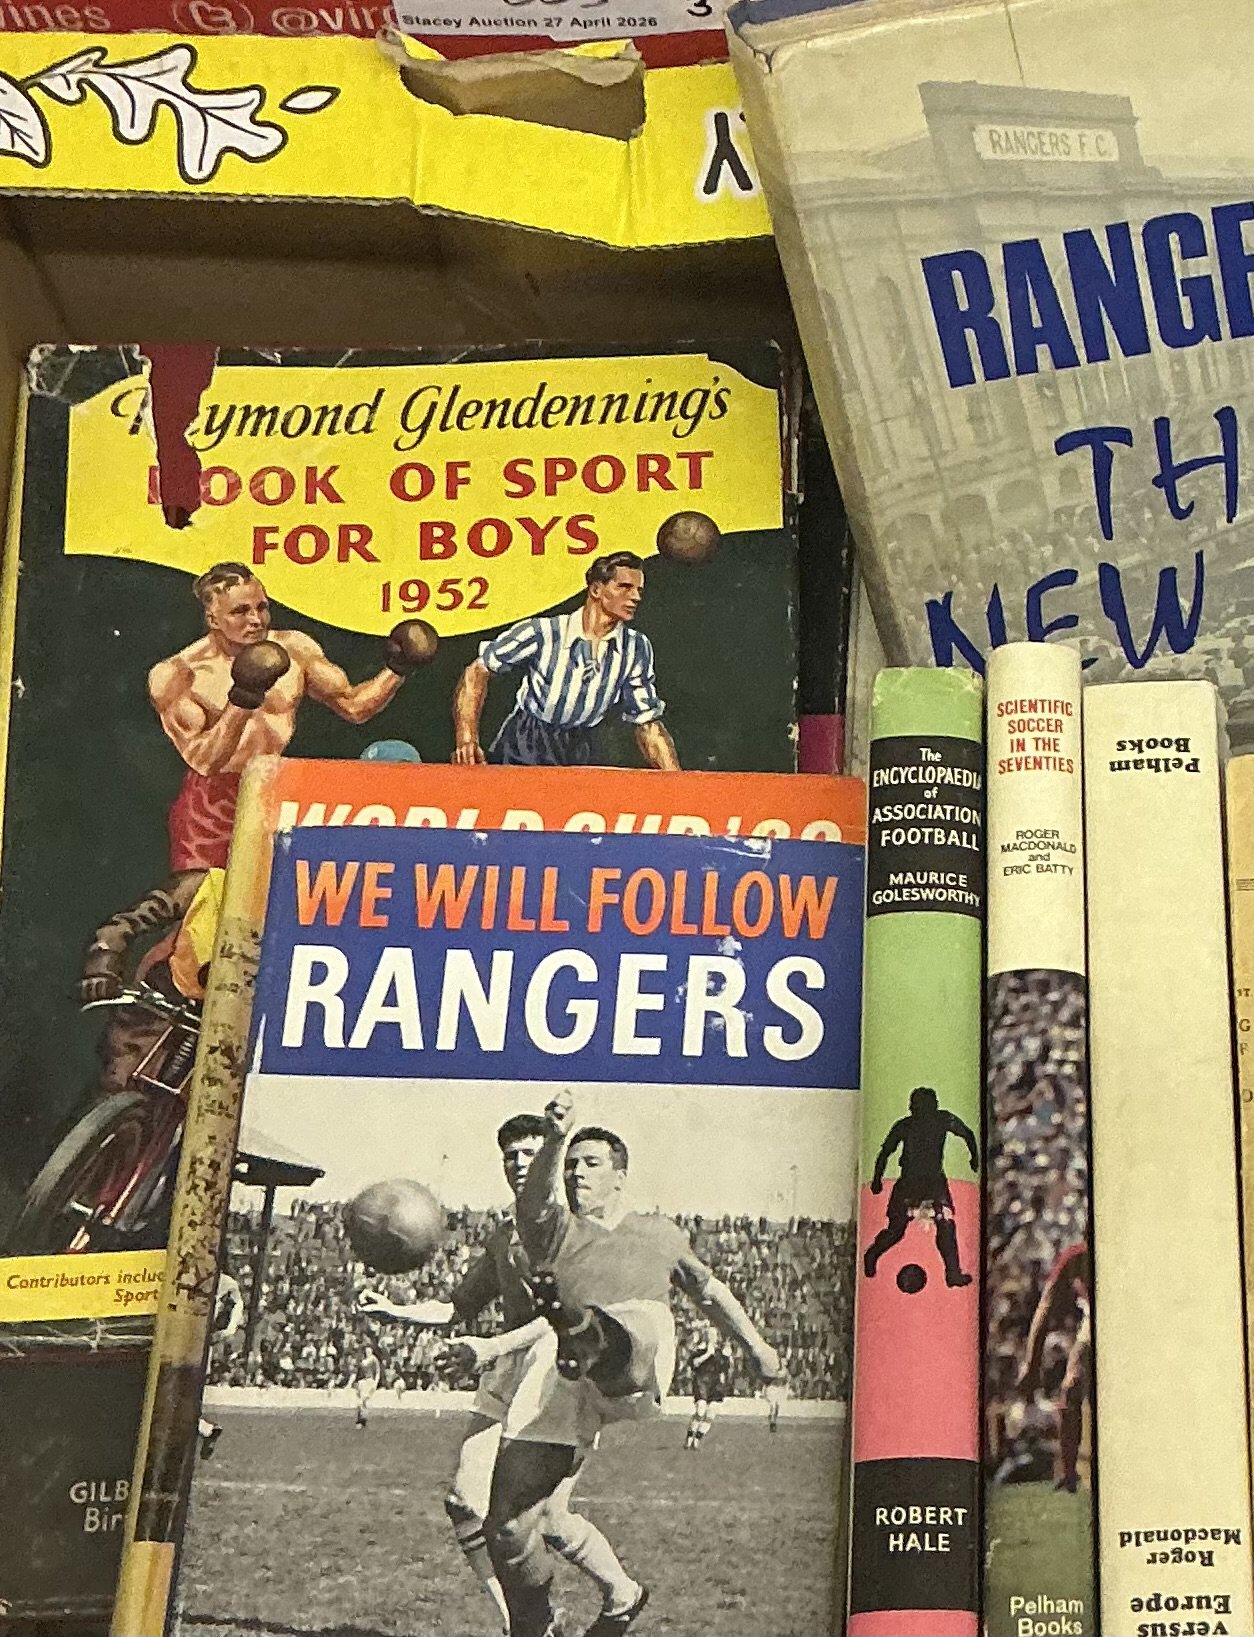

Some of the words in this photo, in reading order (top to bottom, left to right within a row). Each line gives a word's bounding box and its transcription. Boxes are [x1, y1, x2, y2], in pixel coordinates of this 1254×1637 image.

[0, 2, 111, 31] ines
[403, 15, 461, 28] Stacey
[469, 16, 537, 28] Auction
[544, 17, 562, 28] 27
[570, 16, 611, 29] April
[617, 17, 658, 28] 2026
[988, 128, 1073, 157] RANGERS
[111, 386, 384, 452] ymond
[394, 375, 732, 451] Glendenning's
[147, 463, 346, 507] OOK
[389, 461, 474, 502] OF
[503, 450, 714, 499] SPORT
[252, 523, 378, 566] FOR
[419, 514, 600, 563] BOYS
[380, 577, 491, 614] 1952
[924, 551, 1205, 674] NEW
[996, 699, 1074, 718] SCIENTIFIC
[1007, 718, 1064, 734] SOCCER
[919, 747, 943, 762] The
[1010, 738, 1026, 754] IN
[1032, 737, 1061, 753] THE
[1116, 737, 1191, 754] Books
[998, 756, 1075, 775] SEVENTIES
[1109, 756, 1201, 774] Pelham
[923, 786, 939, 799] of
[872, 804, 982, 828] ASSOCIATION
[880, 828, 980, 852] FOOTBALL
[1015, 829, 1060, 841] ROGER
[1000, 841, 1077, 854] MACDONALD
[1027, 852, 1051, 862] and
[889, 871, 969, 888] MAURICE
[1003, 864, 1031, 877] ERIC
[1035, 863, 1074, 876] BATTY
[296, 861, 395, 928] WE
[414, 863, 569, 932] WILL
[588, 866, 840, 941] FOLLOW
[872, 888, 981, 908] GOLESWORTHY
[281, 944, 826, 1062] RANGERS
[7, 1270, 111, 1290] Contributors
[70, 1479, 129, 1503] GILB
[84, 1506, 128, 1533] Bir
[875, 1506, 968, 1526] ROBERT
[888, 1532, 951, 1553] HALE
[1118, 1526, 1243, 1547] Macdonald
[1145, 1548, 1216, 1567] Roger
[1009, 1595, 1084, 1618] Pelham
[1130, 1593, 1232, 1615] Europe
[1017, 1617, 1083, 1637] Books
[1136, 1618, 1230, 1637] versus
